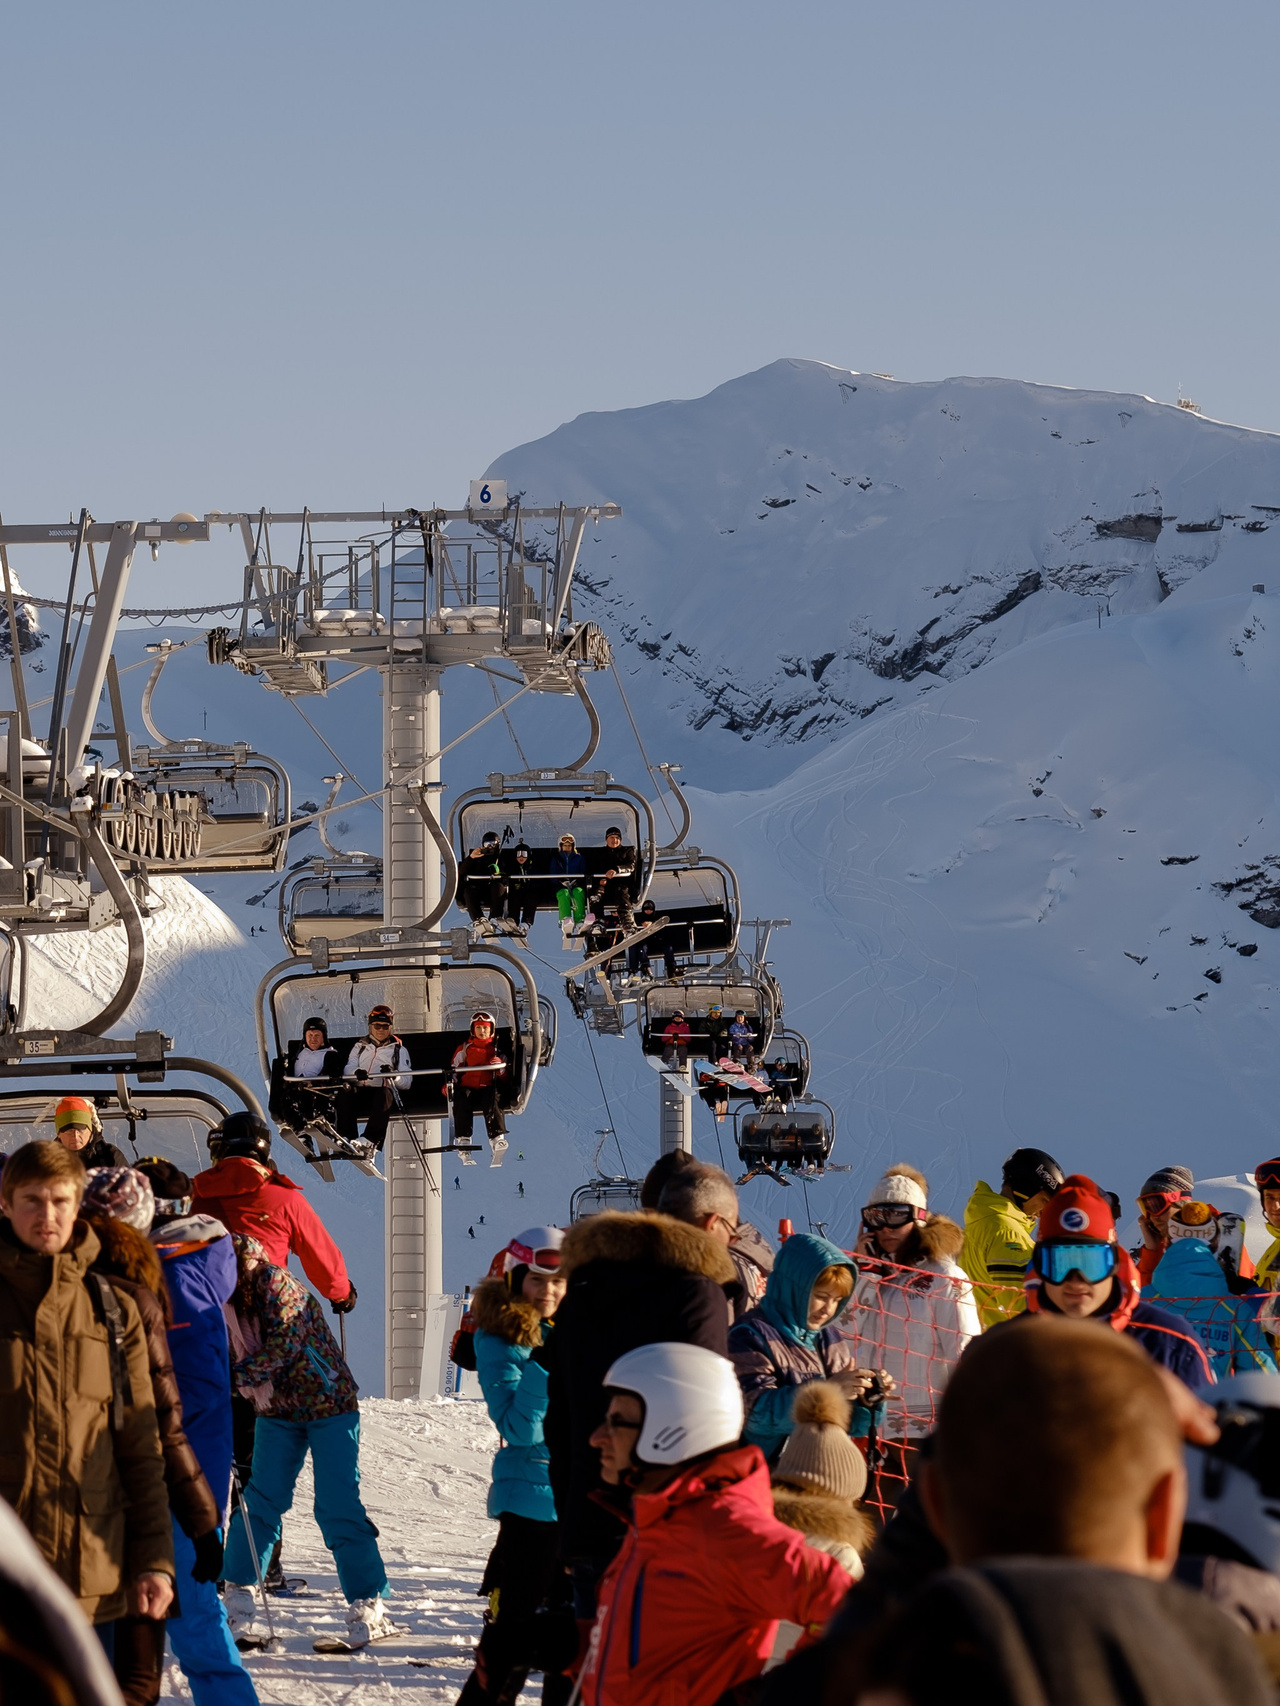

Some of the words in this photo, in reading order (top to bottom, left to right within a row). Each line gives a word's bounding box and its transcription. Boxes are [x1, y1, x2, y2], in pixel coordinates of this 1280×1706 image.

[480, 484, 491, 503] 6
[29, 1041, 40, 1053] 35
[453, 1293, 461, 1307] ISO
[1200, 1327, 1229, 1342] CLUB
